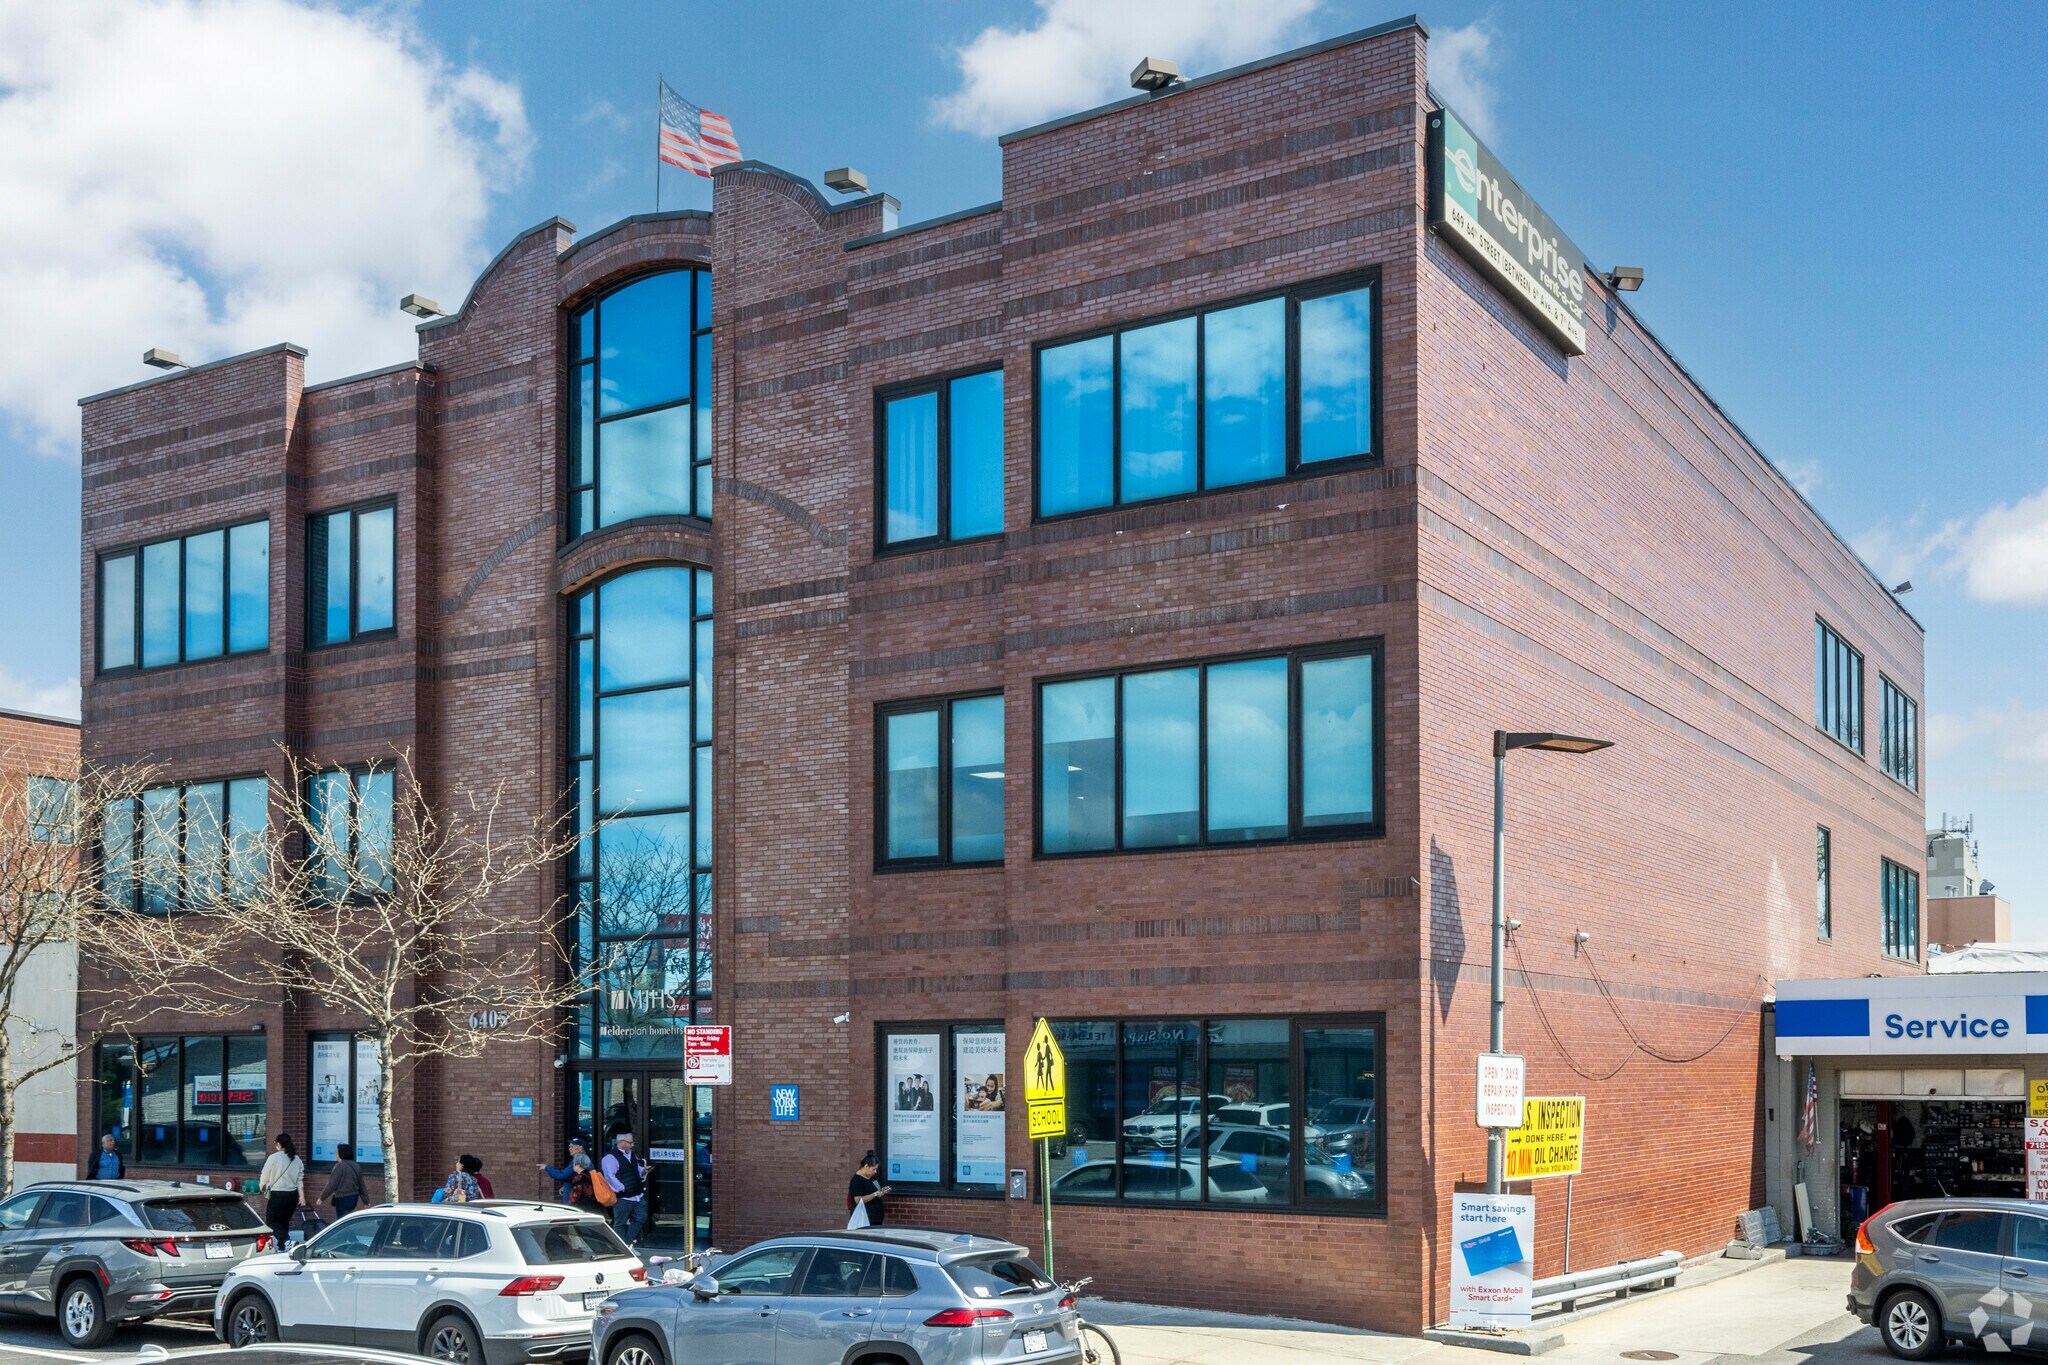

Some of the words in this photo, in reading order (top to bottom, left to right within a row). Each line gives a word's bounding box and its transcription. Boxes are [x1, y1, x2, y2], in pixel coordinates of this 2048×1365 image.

[1446, 148, 1583, 301] enterprise
[1452, 207, 1465, 228] 649
[1480, 234, 1501, 263] STREET
[1540, 268, 1583, 320] rent-a-car
[625, 989, 676, 1013] MJHS
[607, 1026, 647, 1038] elderplan
[649, 1025, 684, 1036] homefirs
[1885, 1013, 2010, 1039] Service
[1484, 1066, 1498, 1079] OPEN
[1505, 1067, 1519, 1080] DAYS
[775, 1089, 795, 1098] NEW
[1483, 1084, 1502, 1096] REPAIR
[1505, 1085, 1519, 1097] SHOP
[772, 1097, 797, 1107] YORK
[776, 1106, 795, 1116] LIFE
[1485, 1103, 1516, 1116] INSPECTION
[1537, 1100, 1581, 1130] INSPECTION
[1032, 1110, 1062, 1126] SCHOOL
[1525, 1134, 1545, 1143] DONE
[1546, 1133, 1567, 1142] HERE!
[1507, 1150, 1516, 1176] 10
[1518, 1148, 1533, 1174] MIN.
[1534, 1147, 1546, 1165] OIL
[1548, 1144, 1579, 1164] CHANGE
[1461, 1202, 1490, 1212] Smart
[1492, 1203, 1526, 1215] savings
[1460, 1213, 1483, 1222] start
[1485, 1213, 1507, 1223] here
[1503, 1286, 1524, 1294] Mobil
[1468, 1293, 1491, 1301] Smart
